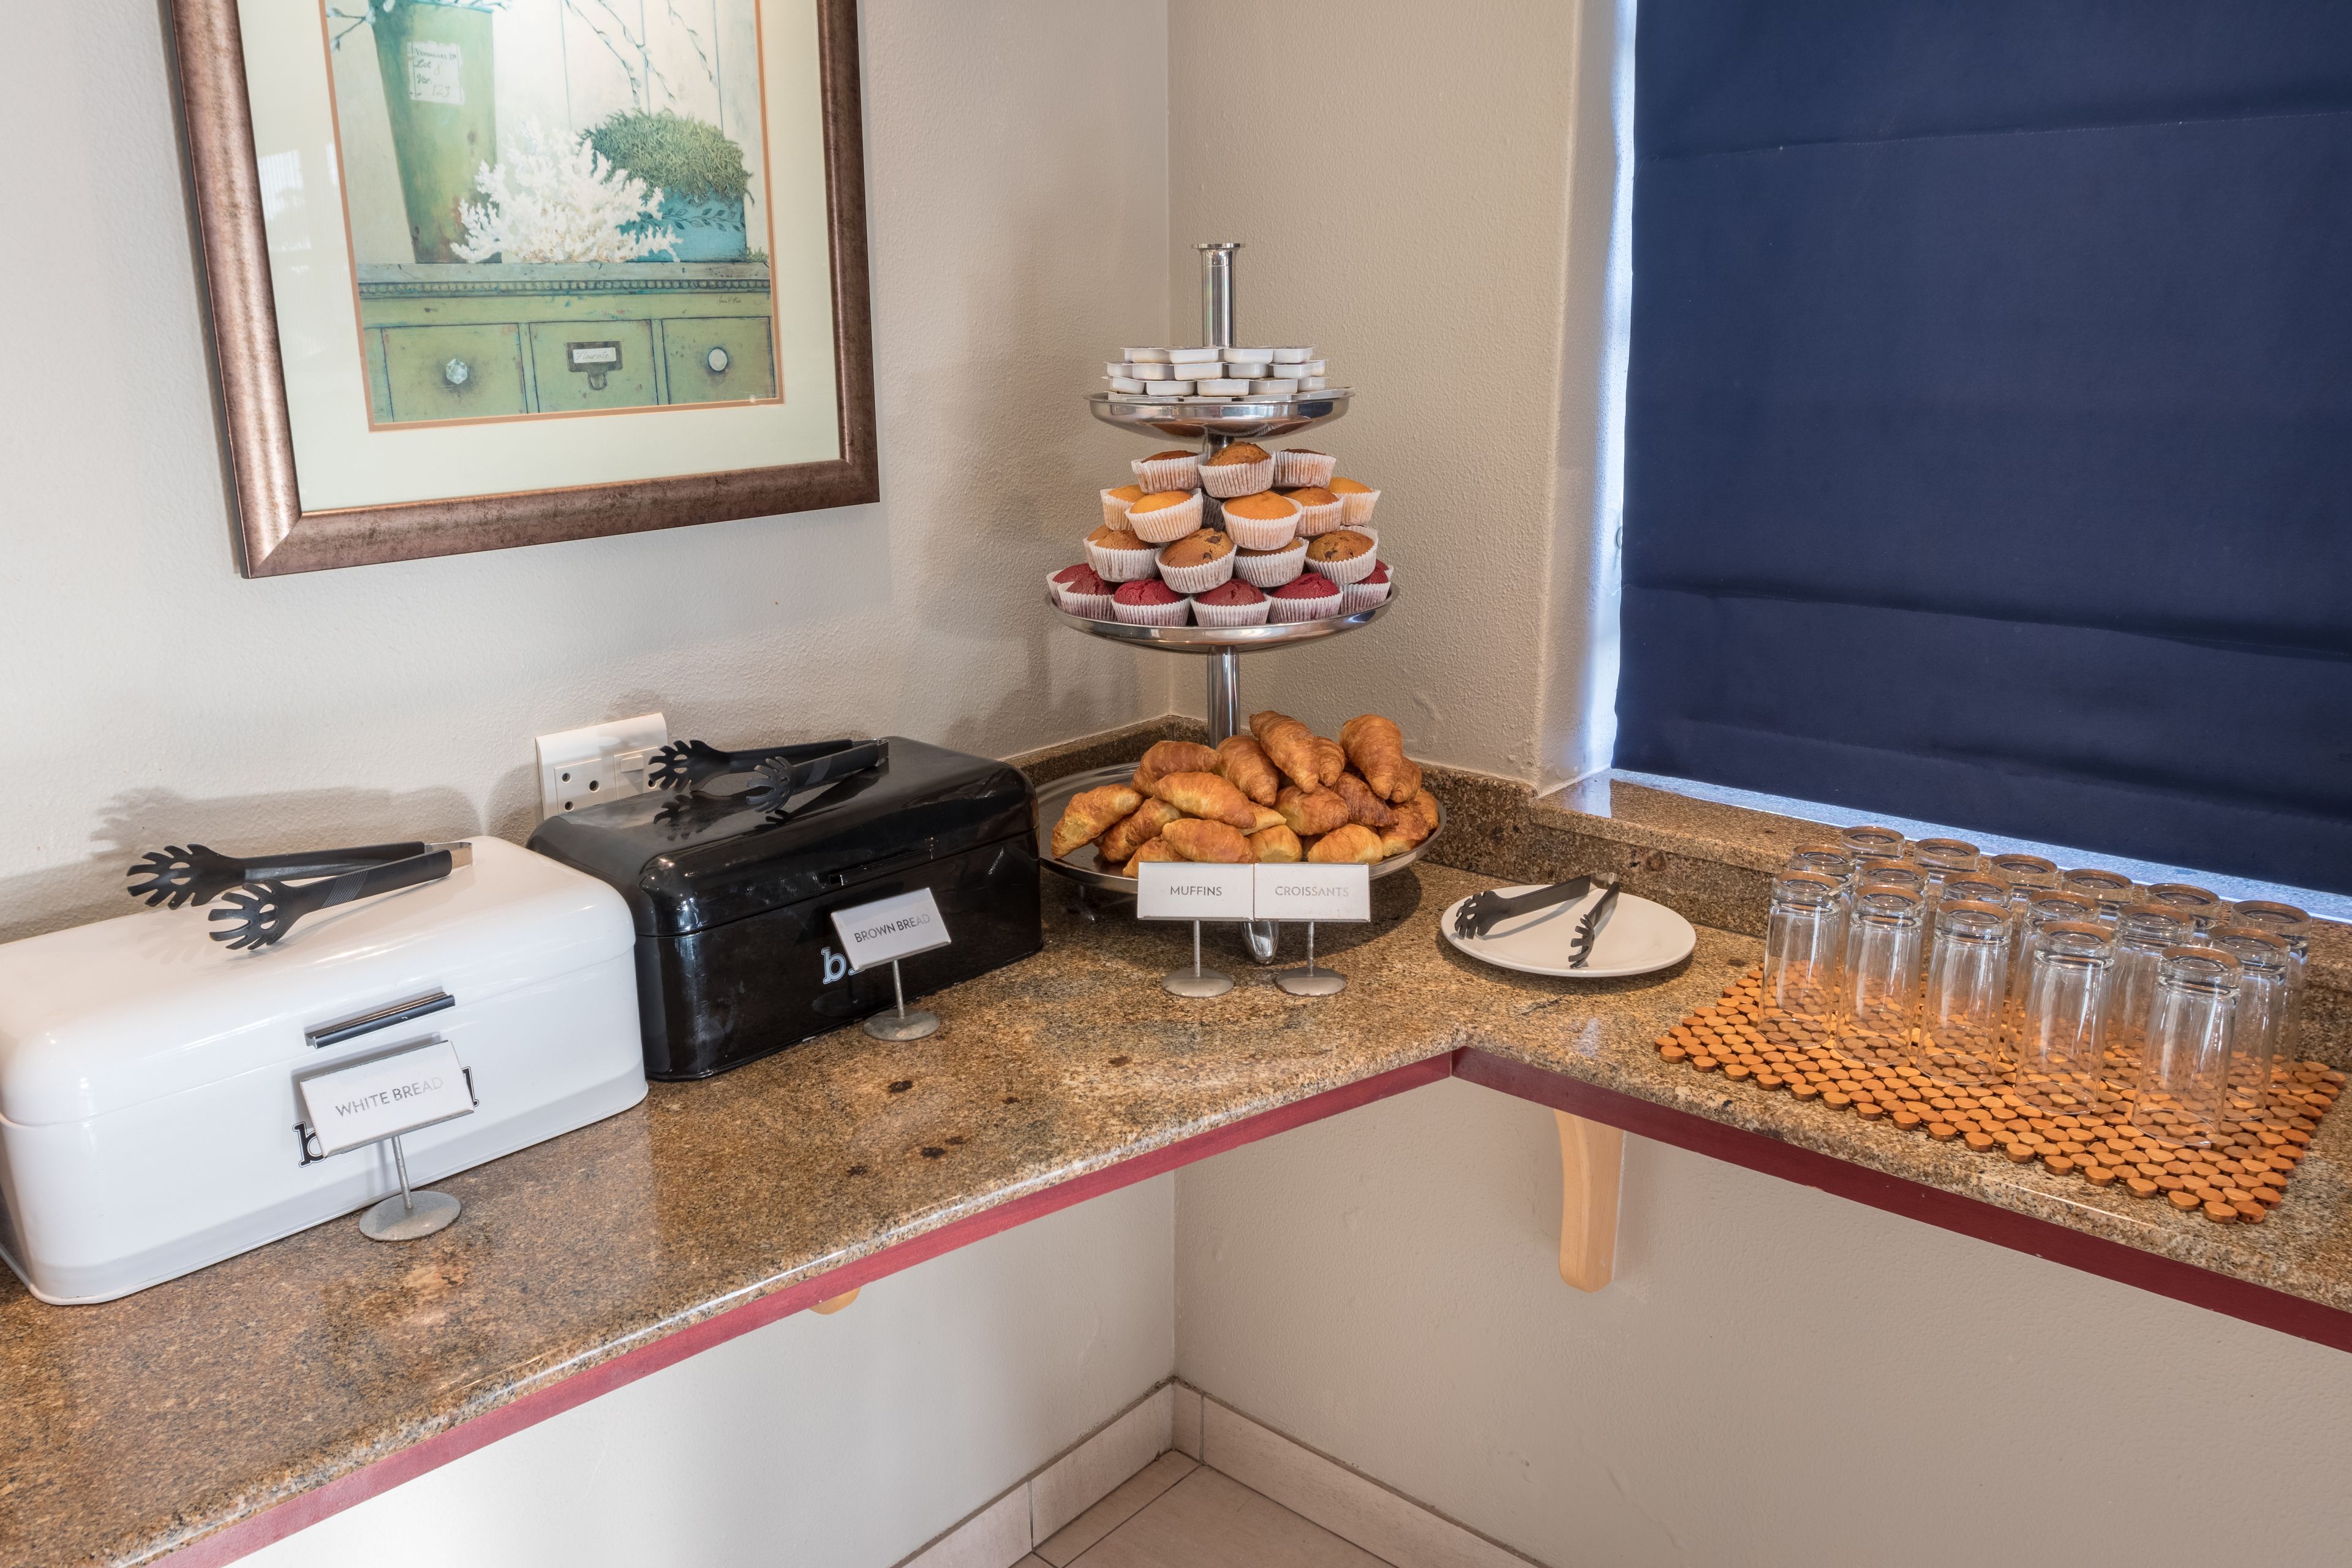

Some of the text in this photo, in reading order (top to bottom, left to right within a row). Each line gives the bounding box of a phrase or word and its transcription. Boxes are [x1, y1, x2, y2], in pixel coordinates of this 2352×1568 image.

[1170, 886, 1223, 897] MUFFINS
[1275, 886, 1349, 897] CROISSANTS
[854, 914, 930, 943] BROWN BREAD
[335, 1091, 390, 1117] WHITE
[392, 1077, 443, 1101] BREAD
